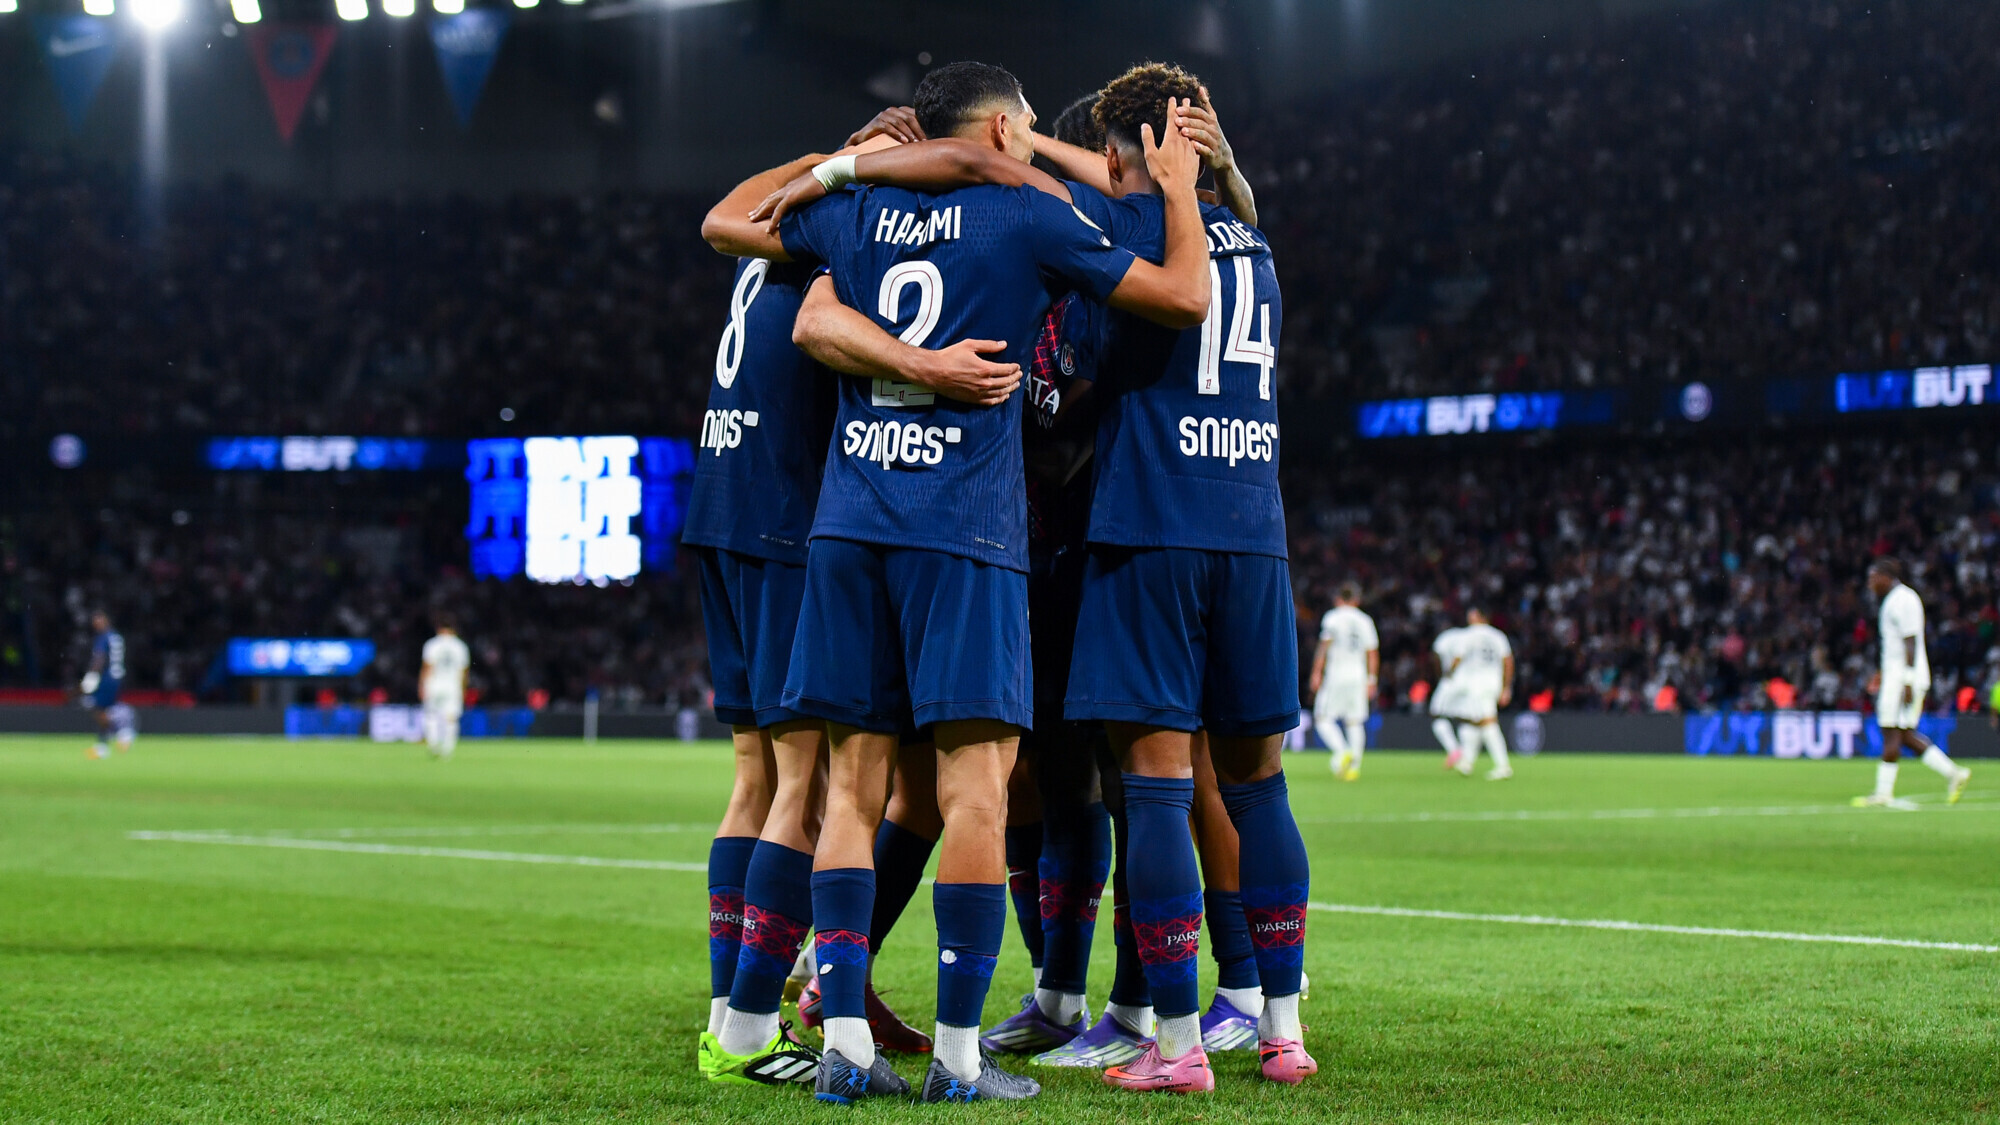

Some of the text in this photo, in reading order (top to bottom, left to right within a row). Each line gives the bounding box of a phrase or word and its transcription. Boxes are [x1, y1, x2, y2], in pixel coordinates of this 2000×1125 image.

[716, 258, 771, 389] 8
[872, 260, 944, 407] 2
[1198, 255, 1275, 401] 14
[1913, 363, 1992, 409] BUT
[1426, 393, 1497, 436] BUT
[844, 420, 945, 471] snipes
[1179, 415, 1273, 467] snipes
[1772, 710, 1863, 760] BUT
[1256, 919, 1300, 933] PARIS
